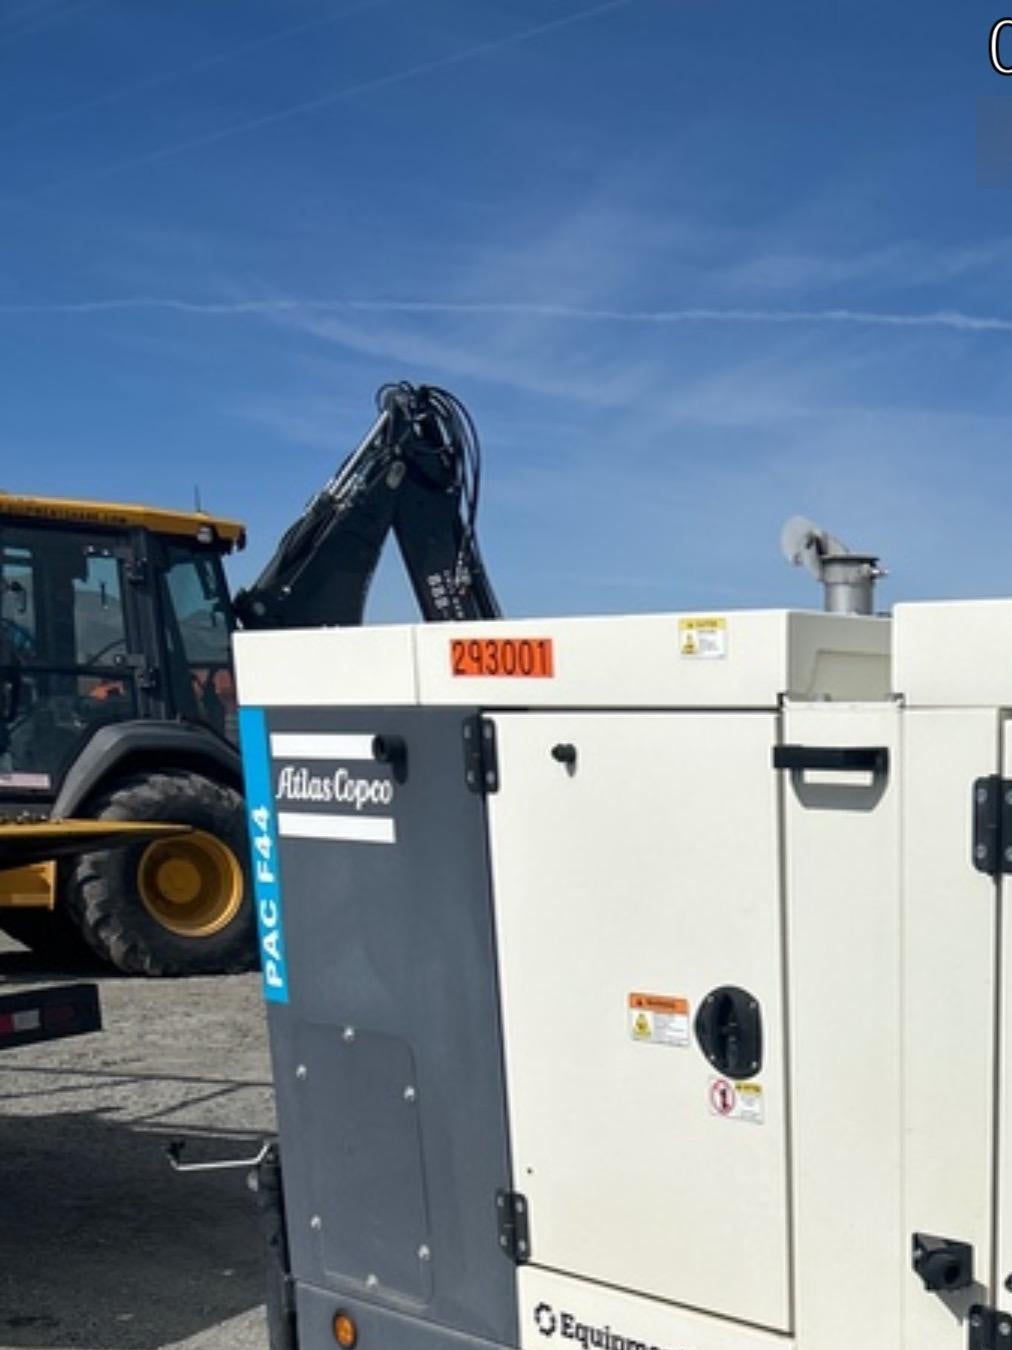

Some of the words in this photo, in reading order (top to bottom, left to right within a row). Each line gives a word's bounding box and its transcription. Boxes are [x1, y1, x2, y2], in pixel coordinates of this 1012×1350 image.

[452, 640, 548, 676] 293001
[252, 805, 275, 883] F44
[260, 900, 283, 988] PAC
